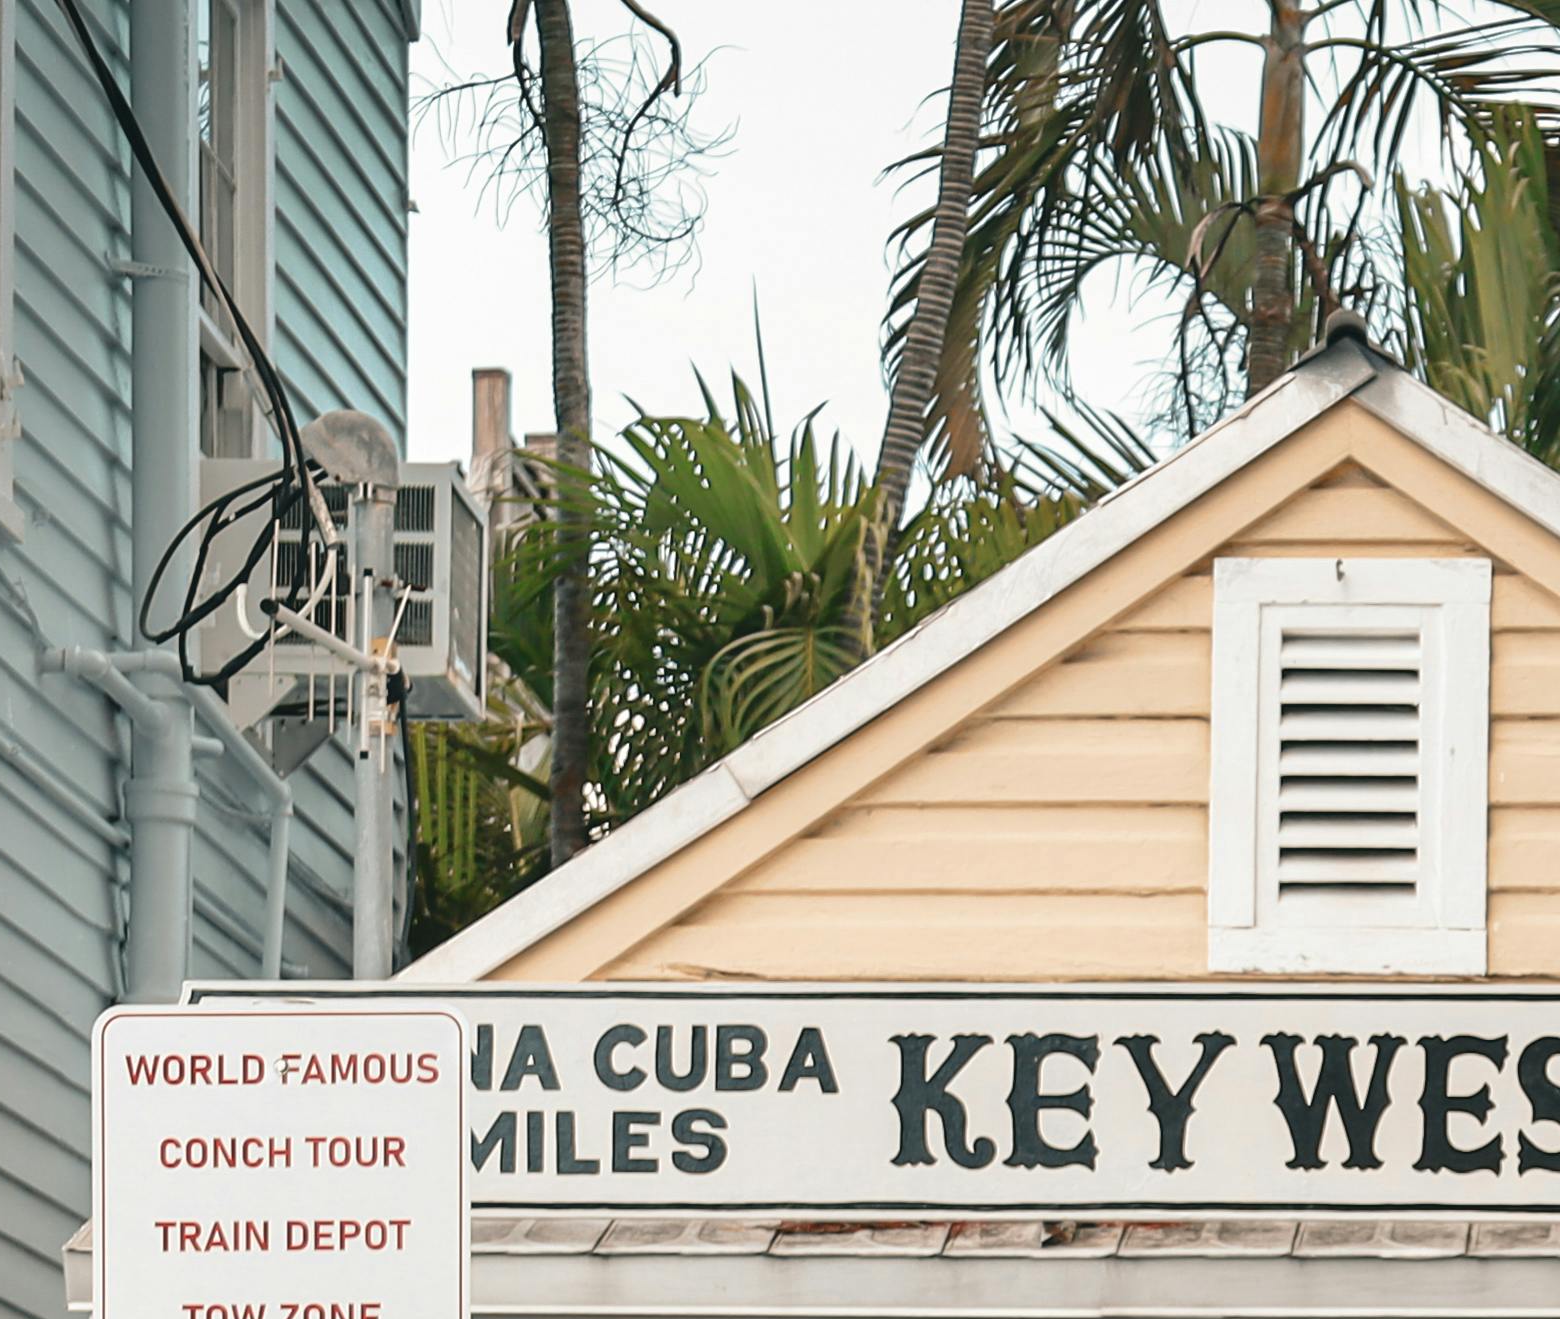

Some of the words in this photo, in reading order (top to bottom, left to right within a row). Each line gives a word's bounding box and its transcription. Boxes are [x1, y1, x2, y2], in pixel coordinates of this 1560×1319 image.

[124, 1054, 265, 1087] WORLD
[278, 1052, 440, 1086] FAMOUS
[593, 1023, 840, 1094] CUBA
[887, 1031, 1238, 1174] KEY
[160, 1137, 292, 1169] CONCH
[305, 1136, 406, 1168] TOUR
[471, 1109, 729, 1175] MILES
[154, 1221, 272, 1253] TRAIN
[285, 1220, 411, 1252] DEPOT
